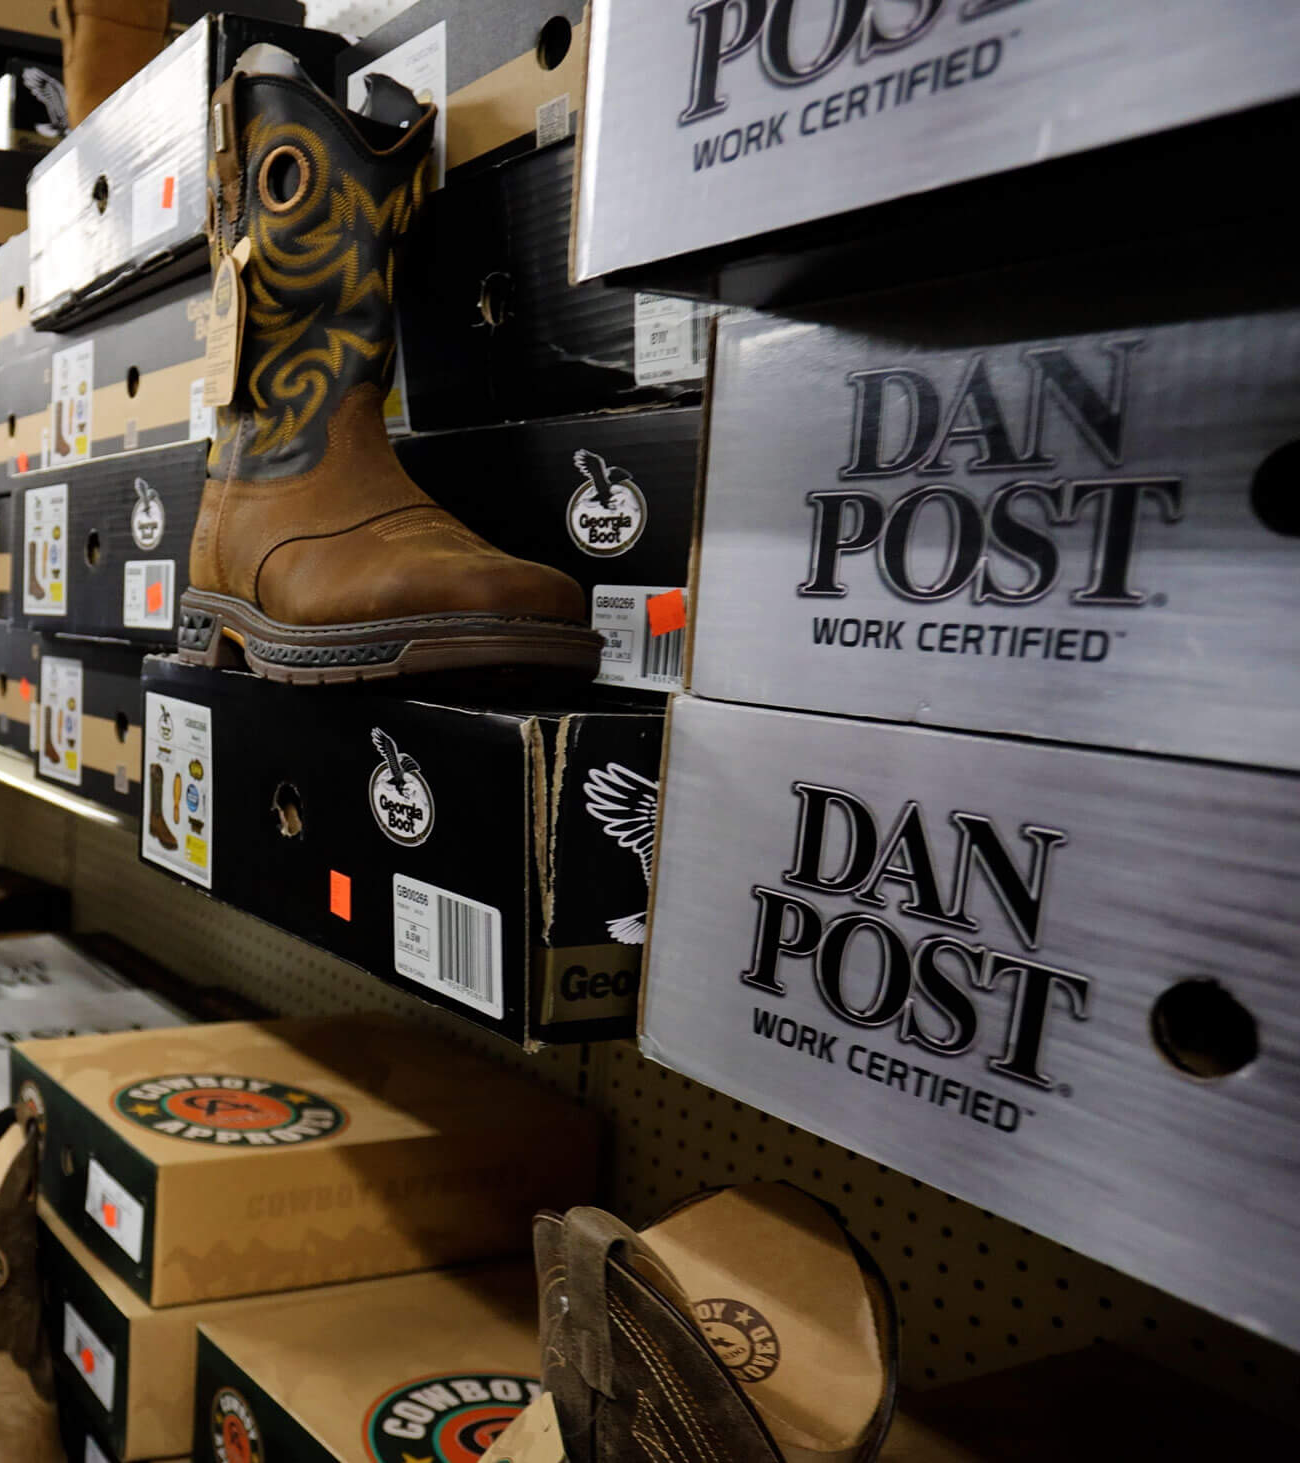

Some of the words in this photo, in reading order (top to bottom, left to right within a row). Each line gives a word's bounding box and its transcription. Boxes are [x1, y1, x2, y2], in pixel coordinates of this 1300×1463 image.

[693, 111, 788, 171] WORK
[800, 38, 1003, 136] CERTIFIED
[838, 336, 1146, 481] DAN
[579, 513, 632, 530] Georgia
[589, 529, 621, 544] Boot
[796, 475, 1186, 608] POST
[813, 617, 905, 650] WORK
[917, 622, 1110, 662] CERTIFIED
[380, 794, 424, 821] Georgia
[388, 812, 416, 834] Boot
[782, 781, 1069, 950] DAN
[740, 885, 1094, 1092] POST
[128, 1076, 273, 1100] COWBOY
[753, 1007, 839, 1063] WORK
[848, 1044, 1021, 1134] CERTIFIED
[153, 1108, 335, 1145] APPROVED
